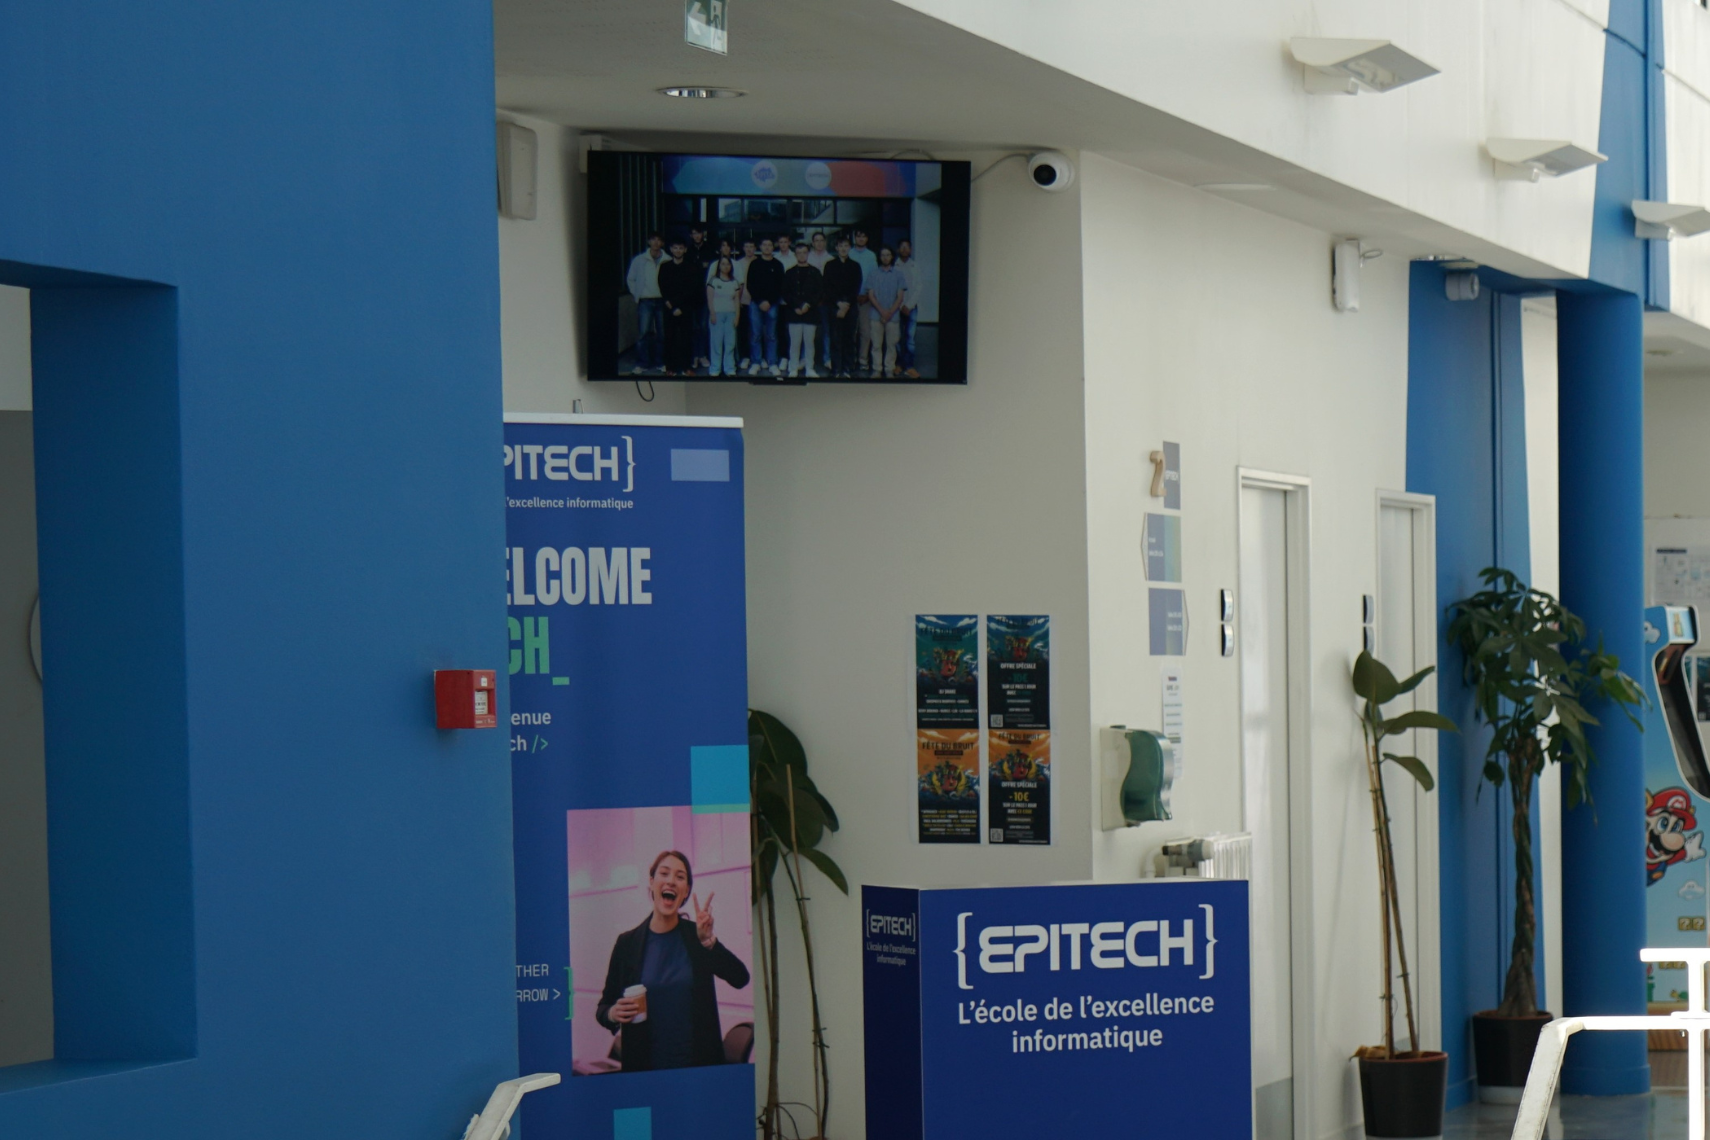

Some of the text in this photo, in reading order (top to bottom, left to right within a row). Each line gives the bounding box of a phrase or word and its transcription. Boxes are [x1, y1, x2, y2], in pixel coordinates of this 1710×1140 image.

[505, 497, 634, 511] 'excellence informatique
[506, 547, 652, 606] LCOME
[511, 711, 552, 727] enue
[958, 993, 1214, 1024] L'école de l'excellence
[1012, 1025, 1163, 1053] informatique
